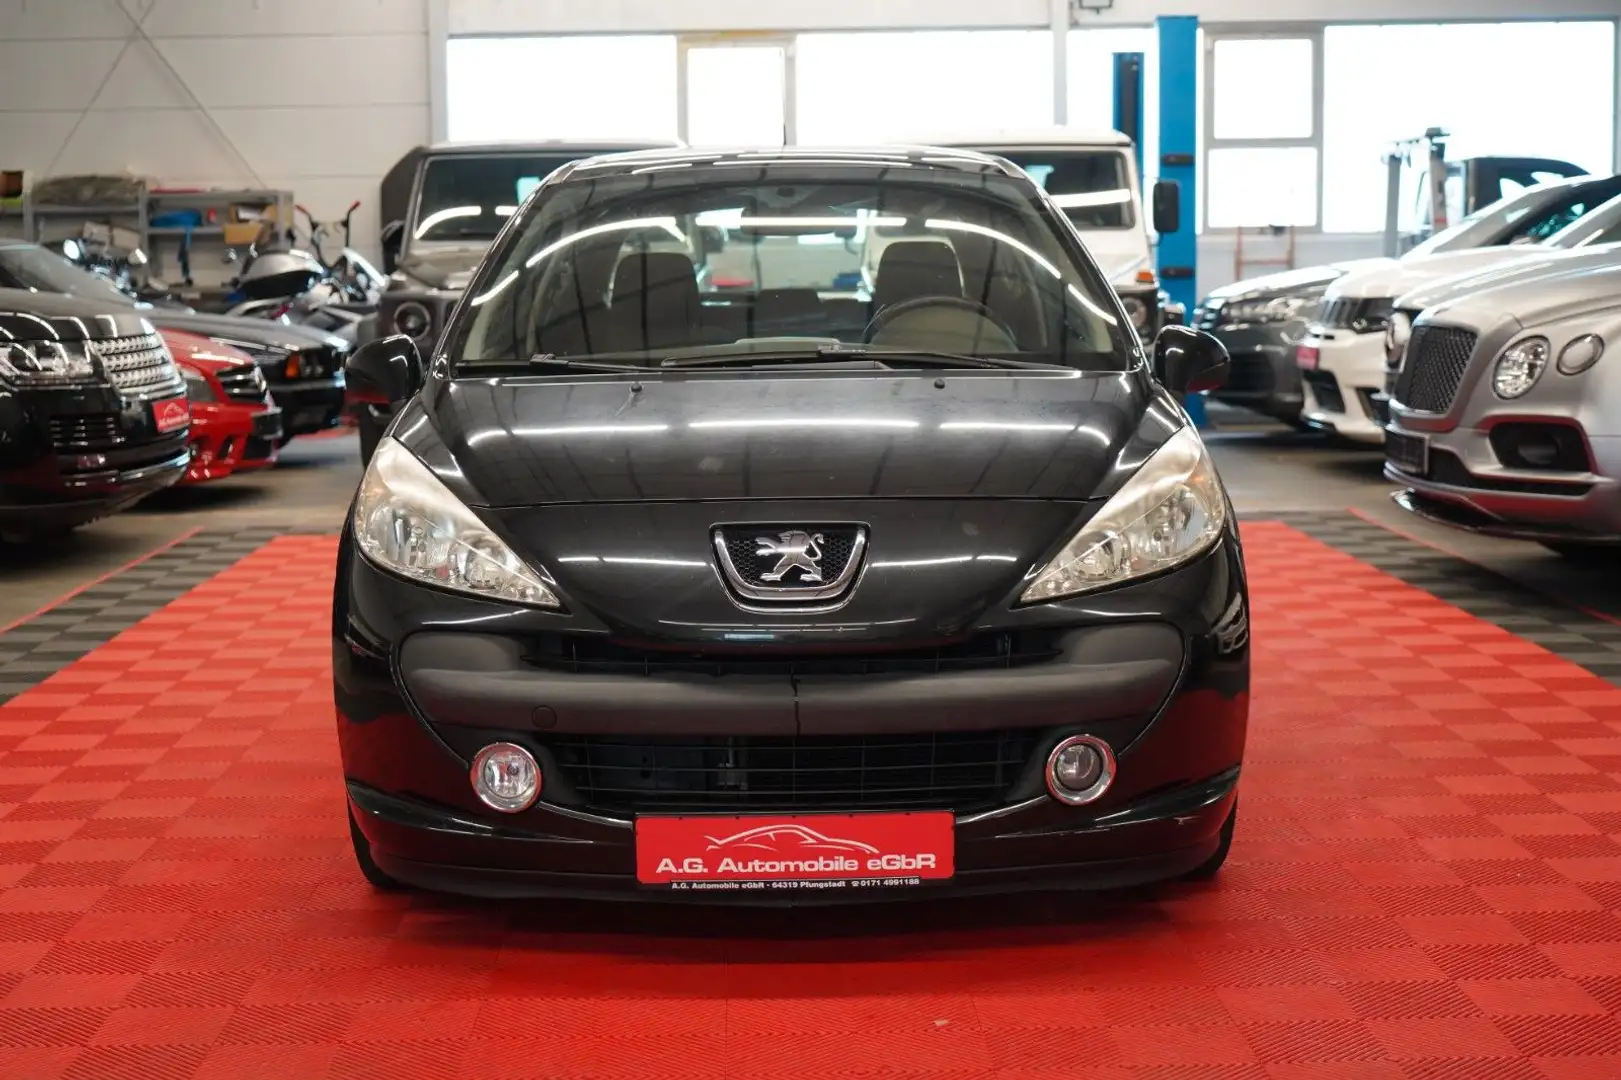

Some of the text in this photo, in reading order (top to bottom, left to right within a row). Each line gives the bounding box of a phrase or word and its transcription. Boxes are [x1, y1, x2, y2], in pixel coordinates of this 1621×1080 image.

[655, 853, 936, 874] A.G. Automobile eGbR
[741, 881, 765, 889] eGbR
[800, 881, 846, 889] Pfungstadt
